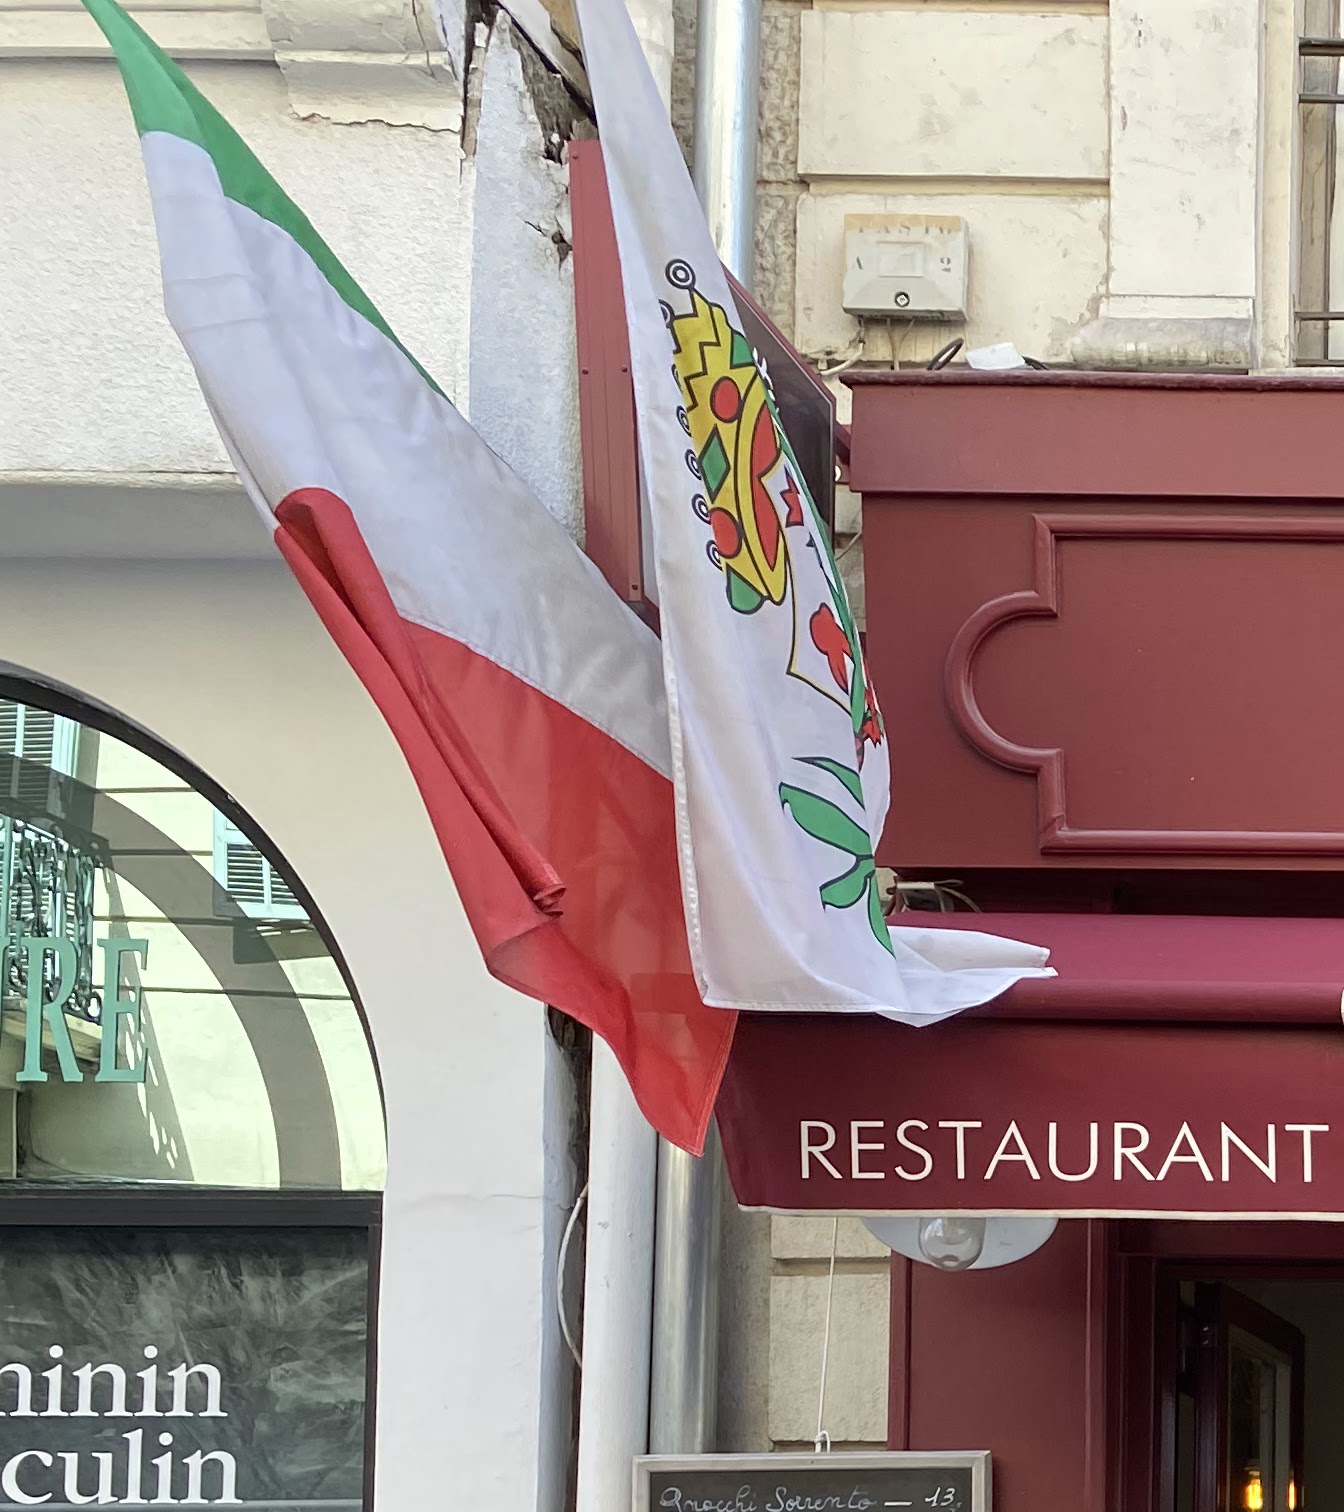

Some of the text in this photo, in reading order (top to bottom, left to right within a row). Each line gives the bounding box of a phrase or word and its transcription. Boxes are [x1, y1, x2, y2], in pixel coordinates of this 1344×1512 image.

[0, 936, 149, 1084] RE
[799, 1119, 1330, 1183] RESTAURANT
[766, 1485, 877, 1512] Sorrento
